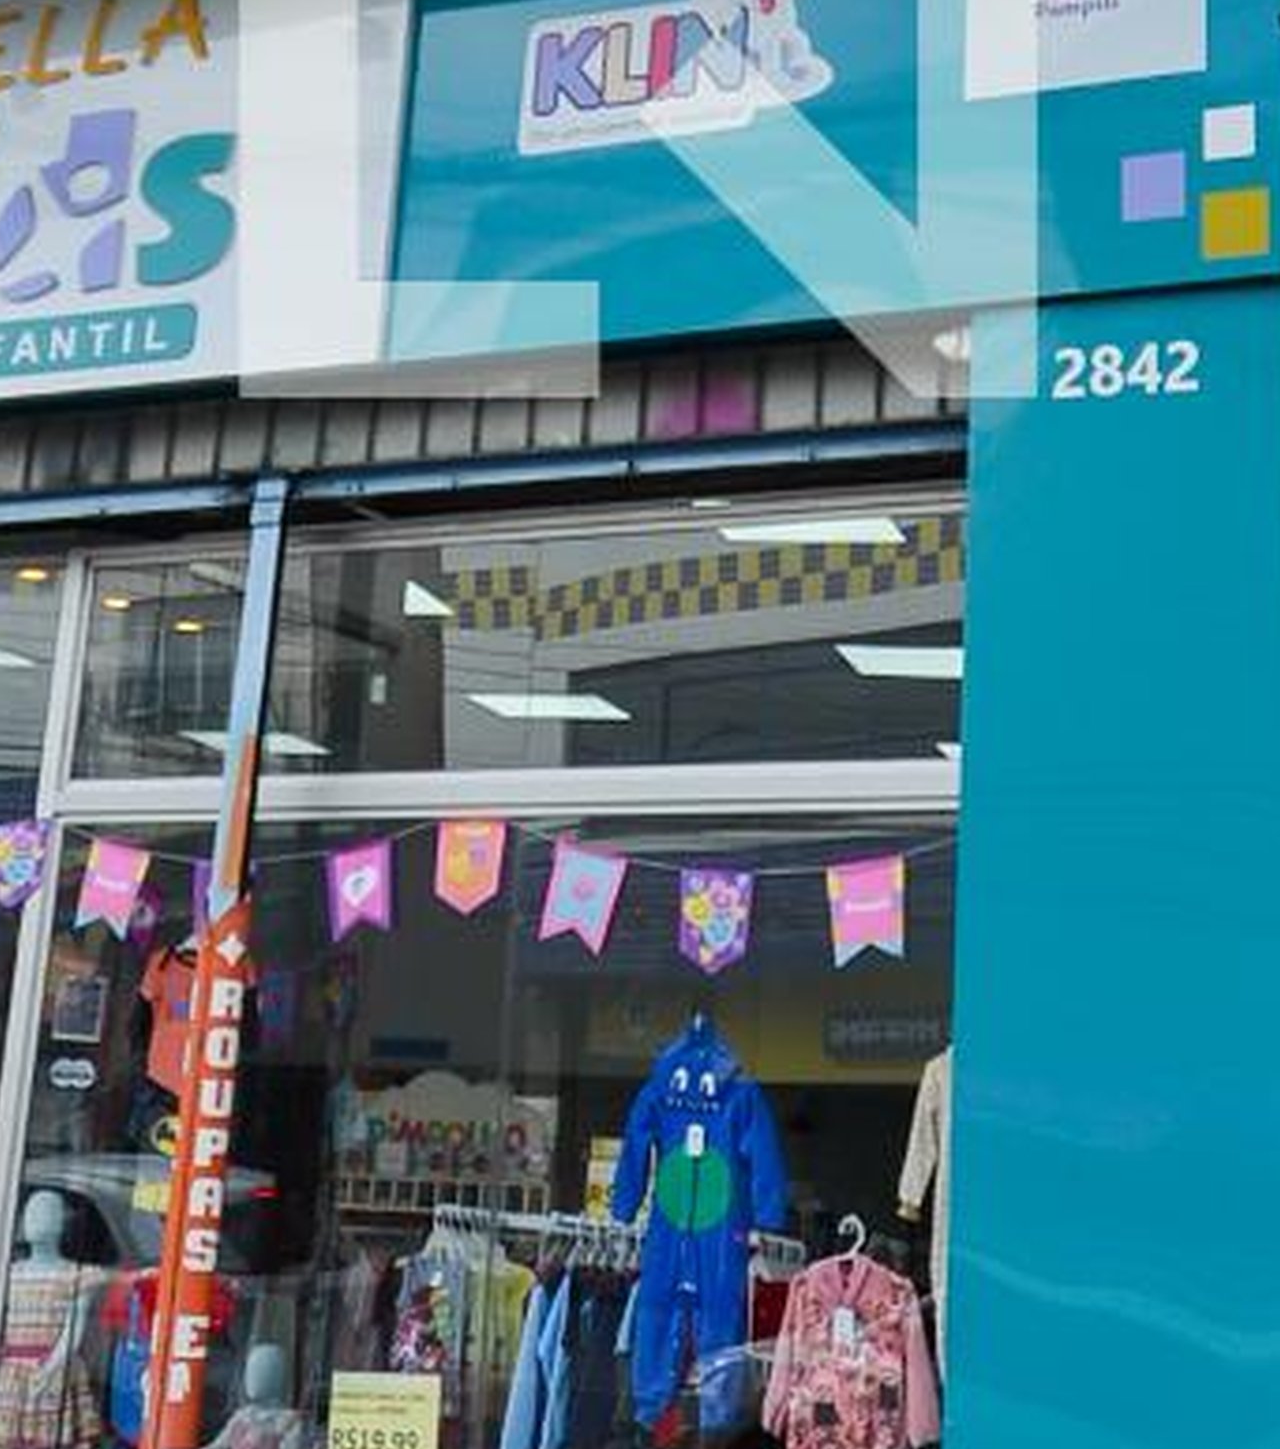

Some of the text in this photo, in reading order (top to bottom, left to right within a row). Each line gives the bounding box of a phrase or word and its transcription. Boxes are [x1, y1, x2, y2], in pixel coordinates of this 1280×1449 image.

[532, 5, 749, 117] KLIN
[1051, 339, 1201, 402] 2842
[181, 979, 243, 1272] ROUPAS
